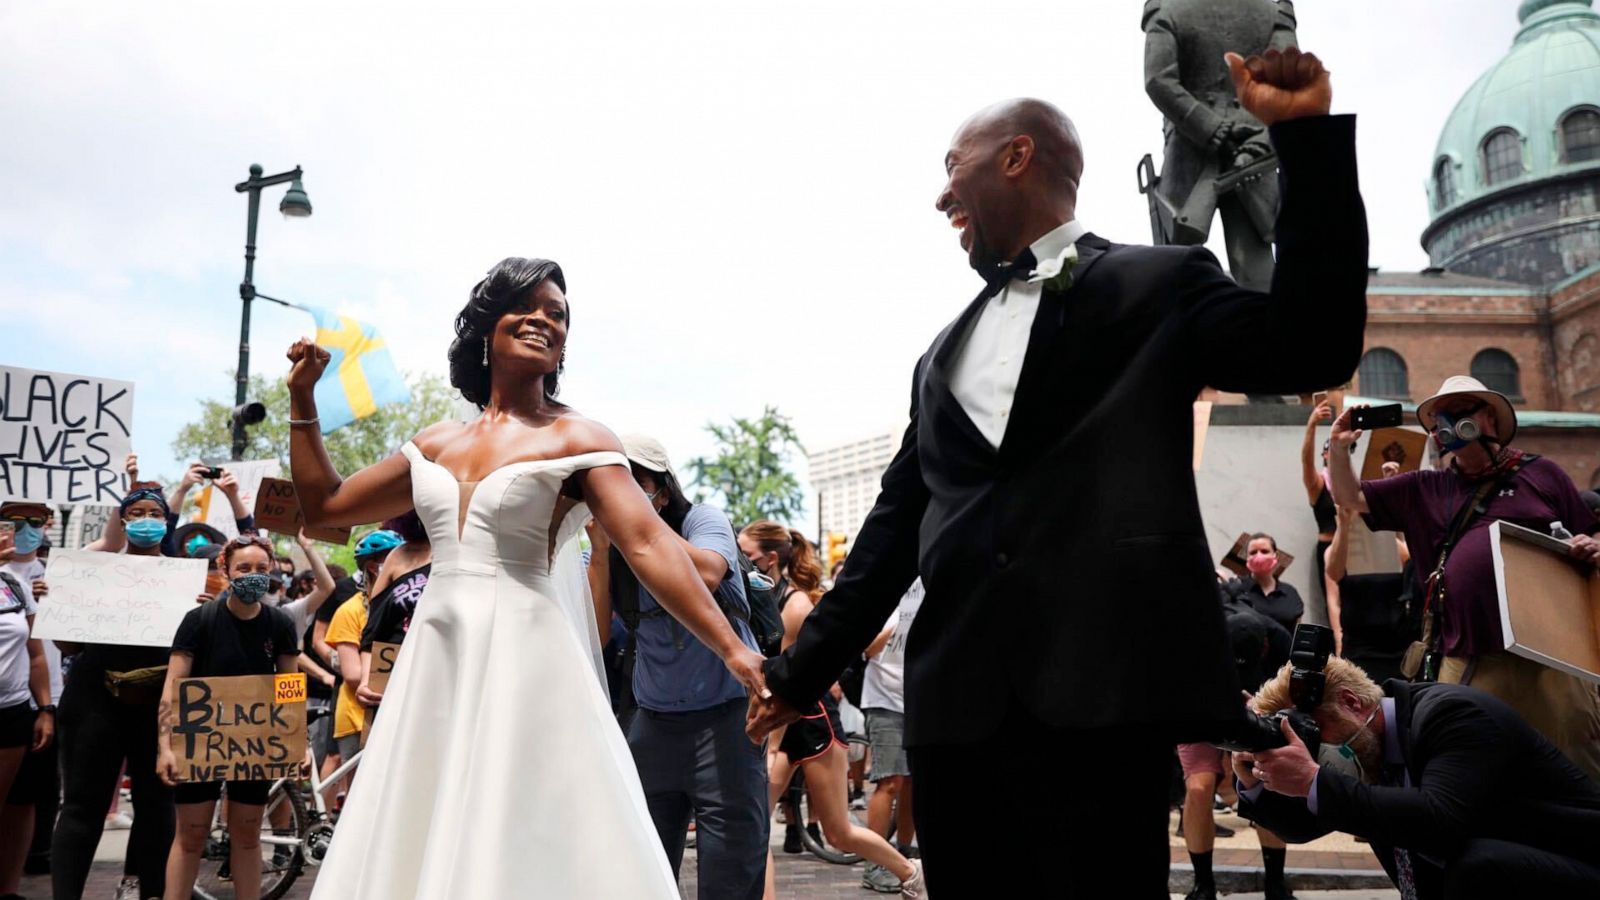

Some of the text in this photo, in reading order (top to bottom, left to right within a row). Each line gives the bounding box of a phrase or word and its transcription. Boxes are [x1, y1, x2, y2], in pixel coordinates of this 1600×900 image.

[0, 372, 130, 437] LACK
[266, 482, 294, 498] NO
[263, 503, 286, 516] NO
[41, 607, 80, 624] Not
[279, 680, 301, 690] OUT
[277, 688, 304, 699] NOW
[178, 680, 289, 728] BLACK
[172, 725, 288, 761] TRANS
